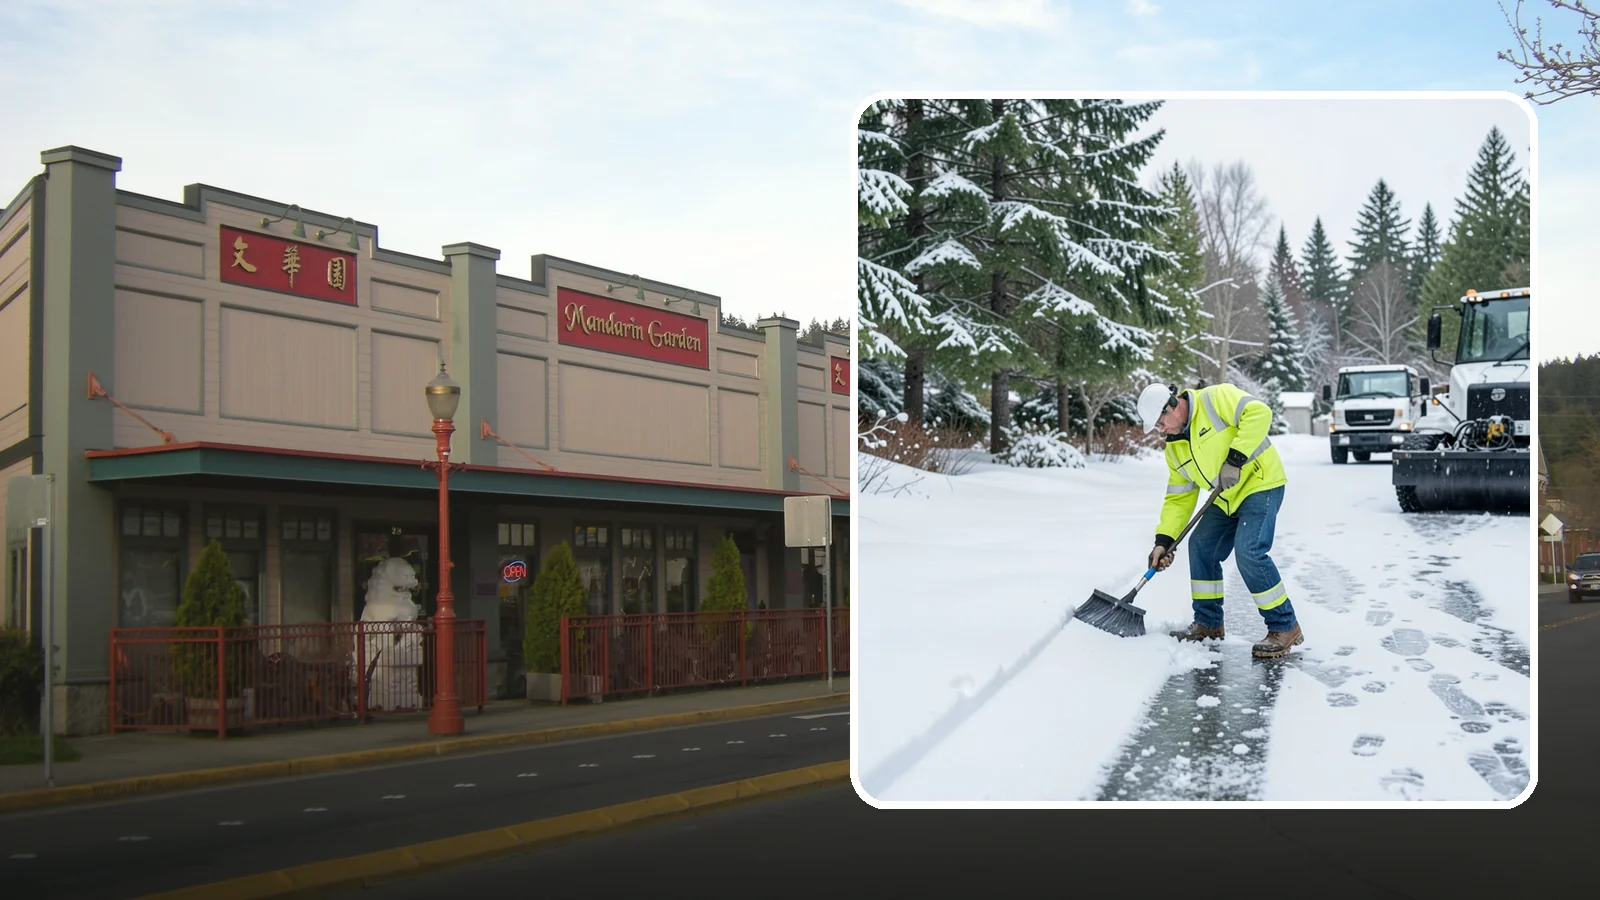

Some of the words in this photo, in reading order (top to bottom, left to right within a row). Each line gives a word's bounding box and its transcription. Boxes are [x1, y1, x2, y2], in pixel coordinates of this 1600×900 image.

[230, 236, 346, 291] 文華園
[564, 302, 644, 341] Mandarin
[648, 320, 702, 352] Garden
[503, 565, 527, 578] OPEN
